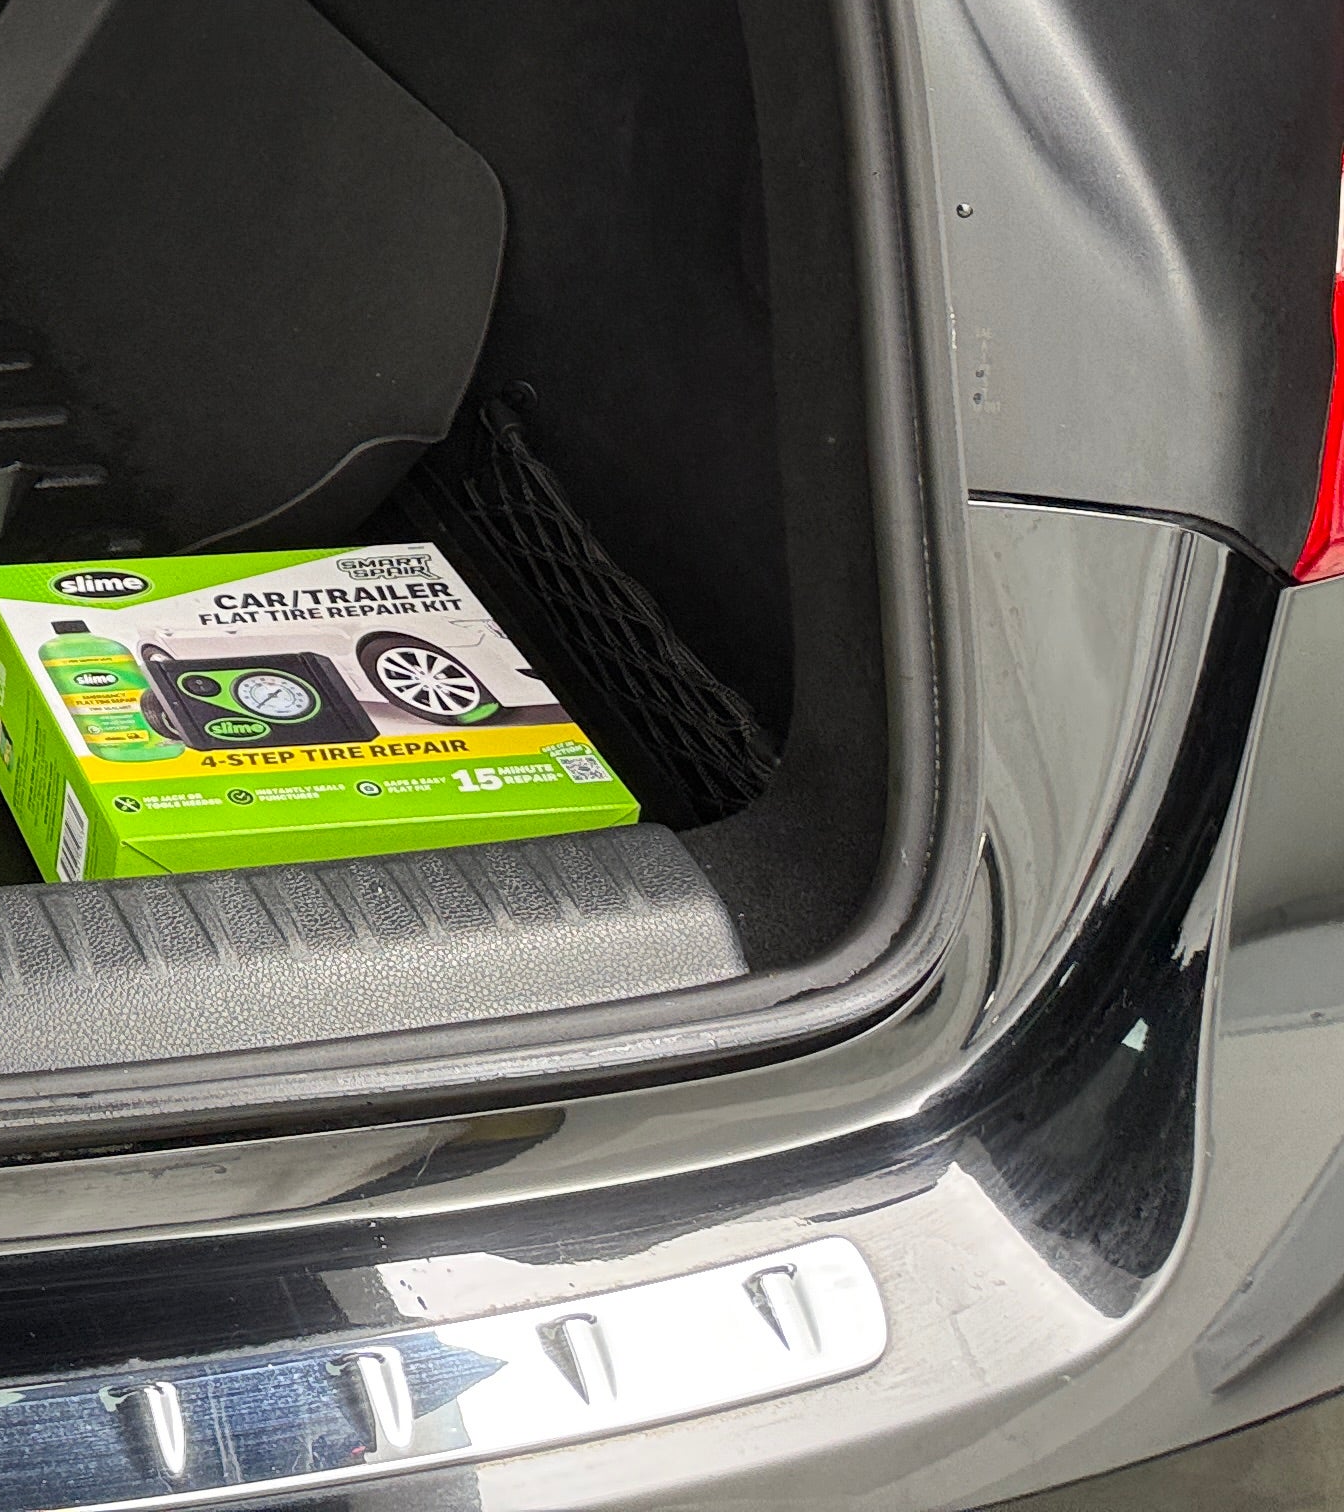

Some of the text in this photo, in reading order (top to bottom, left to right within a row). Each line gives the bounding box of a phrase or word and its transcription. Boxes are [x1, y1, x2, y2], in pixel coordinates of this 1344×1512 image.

[341, 555, 427, 568] SMART
[353, 566, 432, 577] SPAIR
[60, 574, 144, 593] slime
[213, 582, 455, 610] CAR/TRAILER
[198, 599, 462, 625] FLAT TIRE REPAIR KIT
[76, 674, 116, 685] slime
[212, 722, 264, 735] slime
[201, 739, 471, 767] 4-STEP TIRE REPAIR
[451, 764, 554, 792] 15 MINUTE
[255, 786, 311, 796] INSTANTLY
